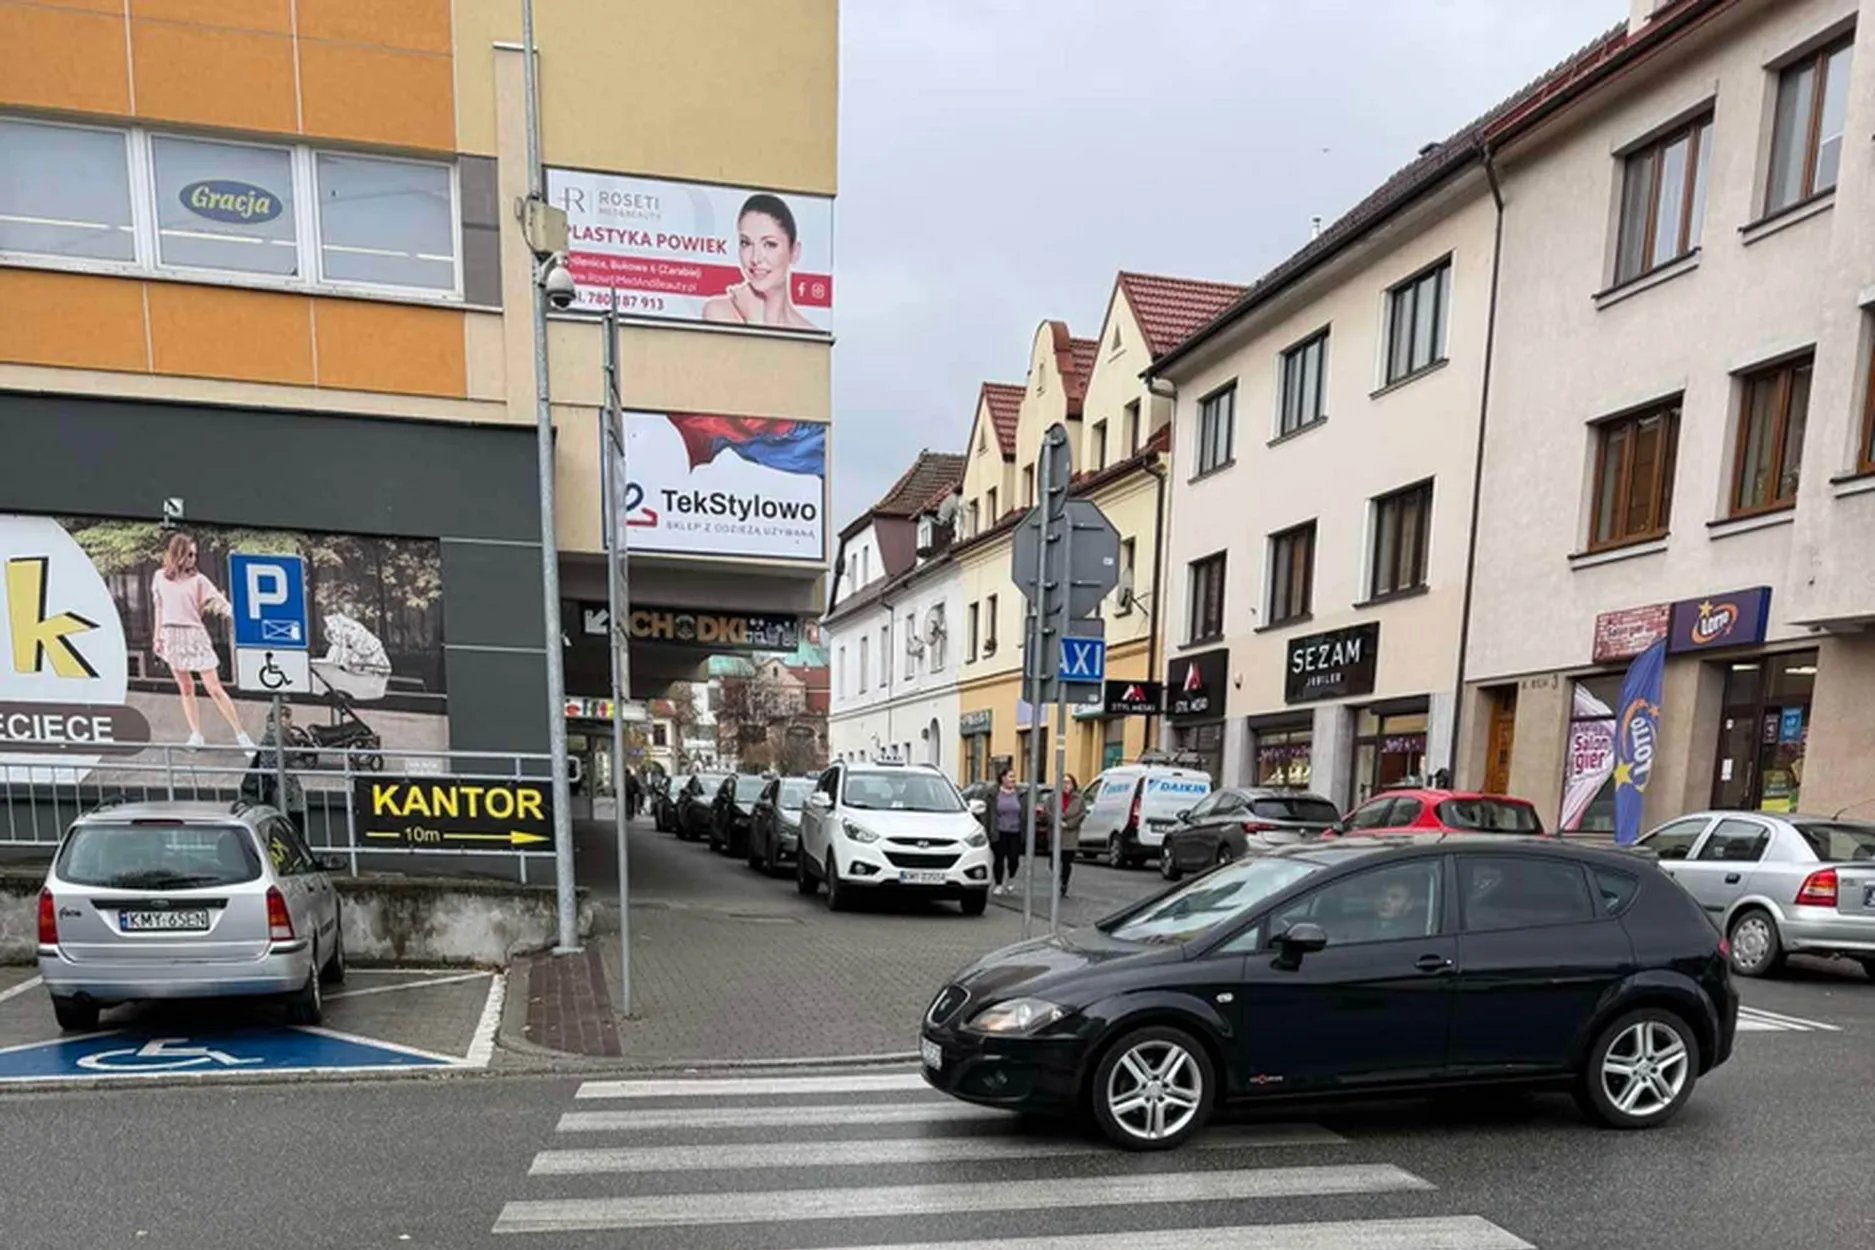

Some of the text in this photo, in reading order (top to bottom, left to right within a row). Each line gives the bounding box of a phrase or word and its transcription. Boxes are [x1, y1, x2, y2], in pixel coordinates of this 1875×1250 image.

[191, 185, 270, 218] Gracja
[598, 190, 661, 211] ROSETI
[656, 232, 728, 255] POWIEK
[640, 297, 665, 311] 913
[661, 490, 817, 522] TekStylowo
[666, 521, 702, 532] SKLEP
[704, 523, 711, 533] Z
[245, 563, 288, 620] P
[1060, 643, 1103, 677] AXI
[1291, 638, 1361, 674] SEZAM
[1575, 751, 1606, 775] gier
[1160, 781, 1207, 794] DAIKIN
[372, 784, 546, 821] KANTOR
[404, 826, 441, 842] 10m
